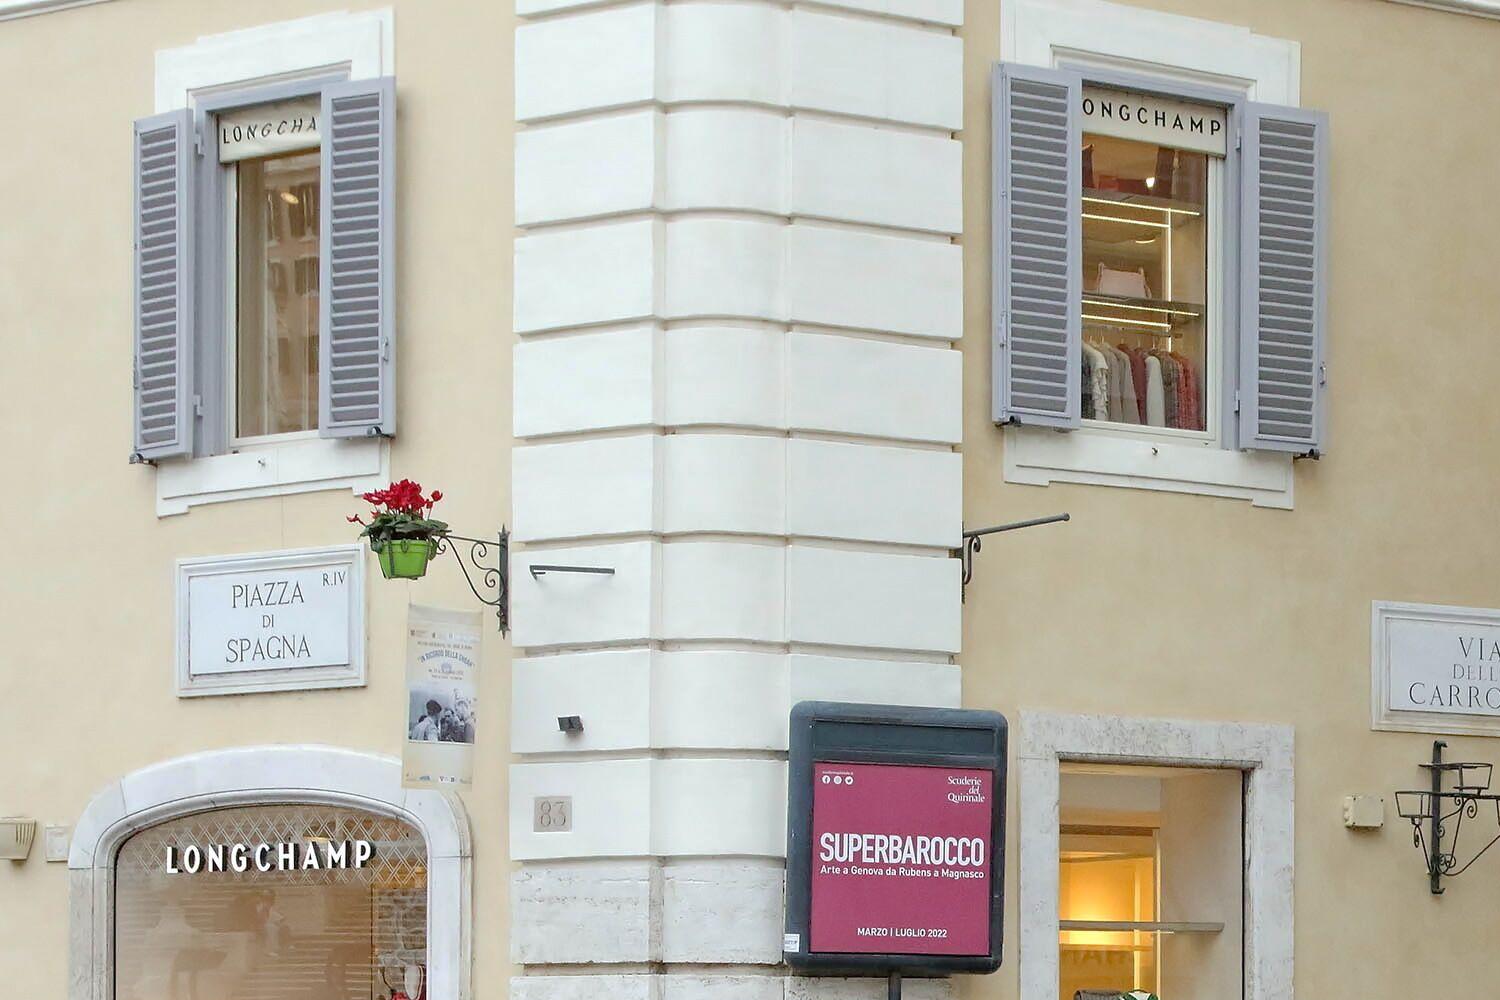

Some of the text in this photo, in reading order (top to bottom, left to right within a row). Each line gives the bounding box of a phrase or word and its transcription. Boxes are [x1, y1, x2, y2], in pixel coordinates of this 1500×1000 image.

[222, 116, 317, 144] LONGCHA
[1082, 98, 1221, 136] ONGCHAMP
[232, 581, 304, 609] PIAZZA
[262, 614, 274, 628] DI
[226, 634, 311, 663] SPAGNA
[947, 775, 982, 786] Scuderie
[968, 785, 980, 795] del
[947, 792, 985, 803] Quirinale
[540, 800, 566, 827] 83
[166, 840, 374, 874] LONGCHAMP
[819, 832, 985, 866] SUPERBAROCCO
[820, 865, 985, 880] Arte a Genova da Rubens a Magnasco
[857, 927, 888, 937] MARZO
[895, 928, 926, 937] LUGLIO
[927, 928, 948, 938] 2022
